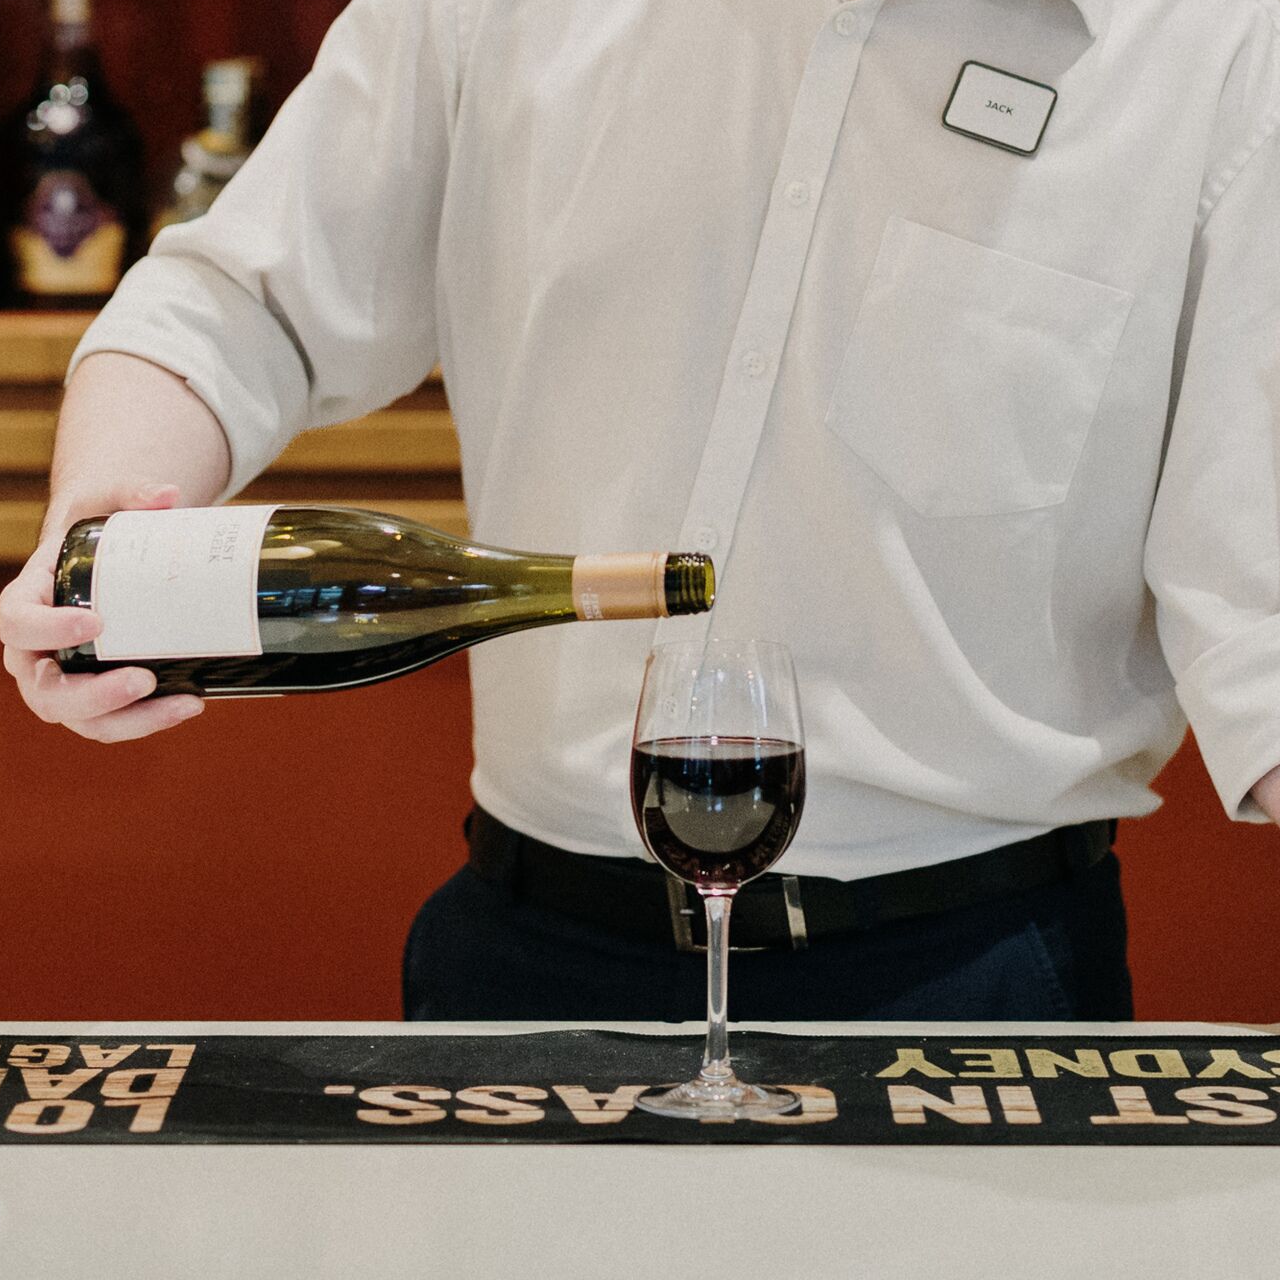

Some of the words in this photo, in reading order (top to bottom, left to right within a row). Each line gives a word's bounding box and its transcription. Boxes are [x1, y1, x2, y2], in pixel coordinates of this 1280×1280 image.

[985, 100, 1014, 116] JACK
[207, 522, 228, 565] CREEK
[222, 522, 241, 563] FIRST
[324, 1083, 838, 1125] ASS.
[889, 1084, 1040, 1125] IN
